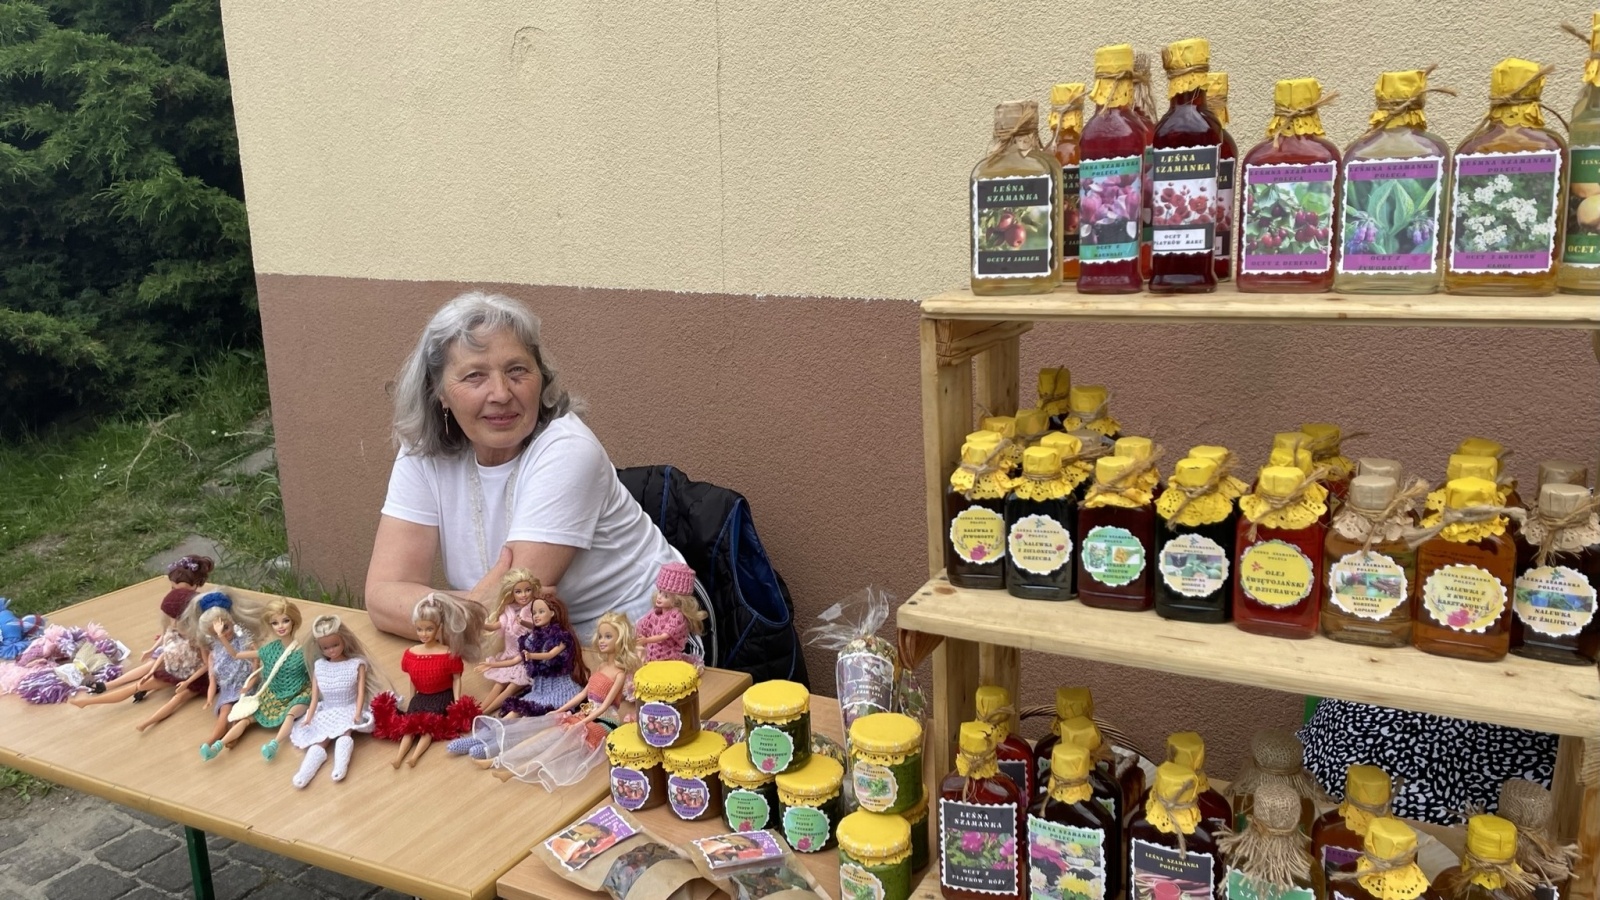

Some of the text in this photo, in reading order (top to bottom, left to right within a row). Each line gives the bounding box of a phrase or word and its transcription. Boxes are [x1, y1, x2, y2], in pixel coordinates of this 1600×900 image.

[1160, 154, 1196, 163] LEŚNA
[1155, 163, 1211, 173] SZAMANKA
[993, 184, 1024, 192] LEŚNA
[986, 193, 1039, 202] SZAMANKA
[1568, 245, 1597, 253] OCET
[1246, 575, 1305, 588] ŚWIĘTOJAŃSKI
[1444, 585, 1479, 595] NALEWKA
[1534, 608, 1571, 618] NALEWKA
[960, 811, 989, 820] LEŚNA
[954, 818, 1002, 829] SZAMANKA
[1049, 833, 1075, 842] POLECA
[1058, 829, 1097, 840] SZAMANKA
[1145, 852, 1199, 869] LEŚNA SZAMANKA
[962, 868, 981, 876] OCET
[1159, 863, 1184, 873] POLECA
